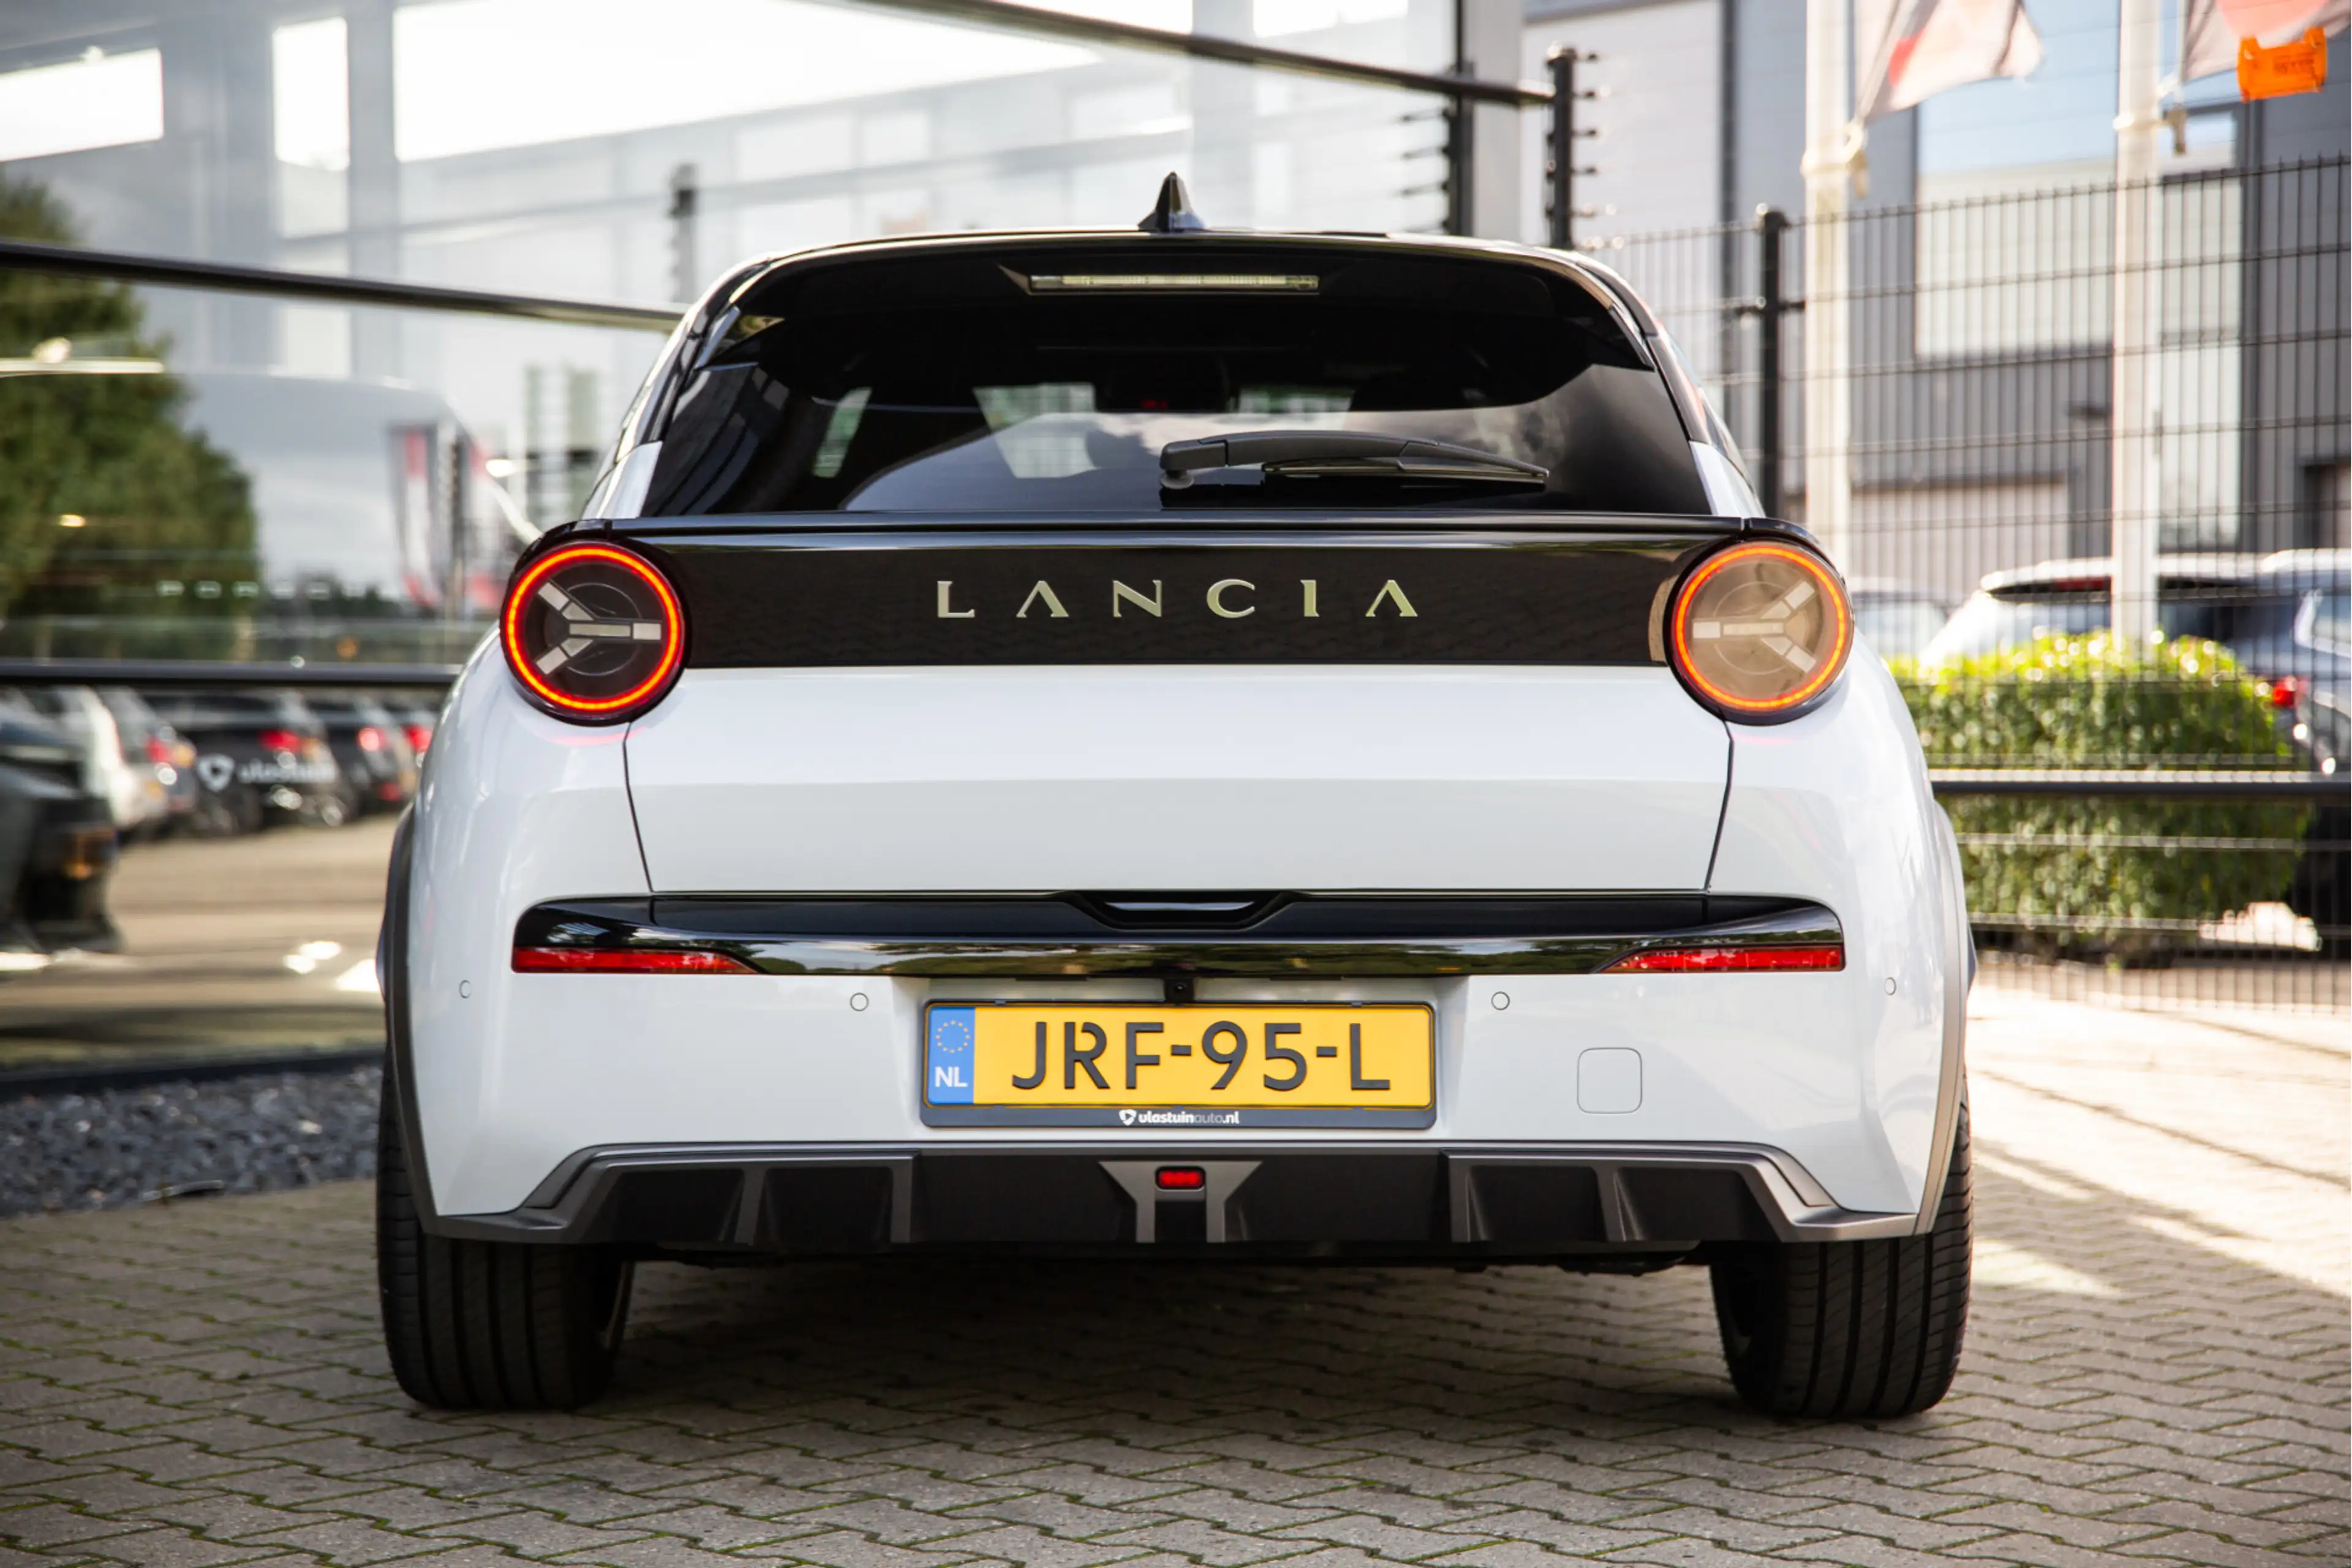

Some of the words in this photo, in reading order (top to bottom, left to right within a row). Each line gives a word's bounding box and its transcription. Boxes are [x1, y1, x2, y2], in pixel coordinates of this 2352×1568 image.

[937, 578, 1418, 619] LANCIA
[1012, 1021, 1390, 1091] JRF-95-L
[935, 1066, 968, 1088] NL
